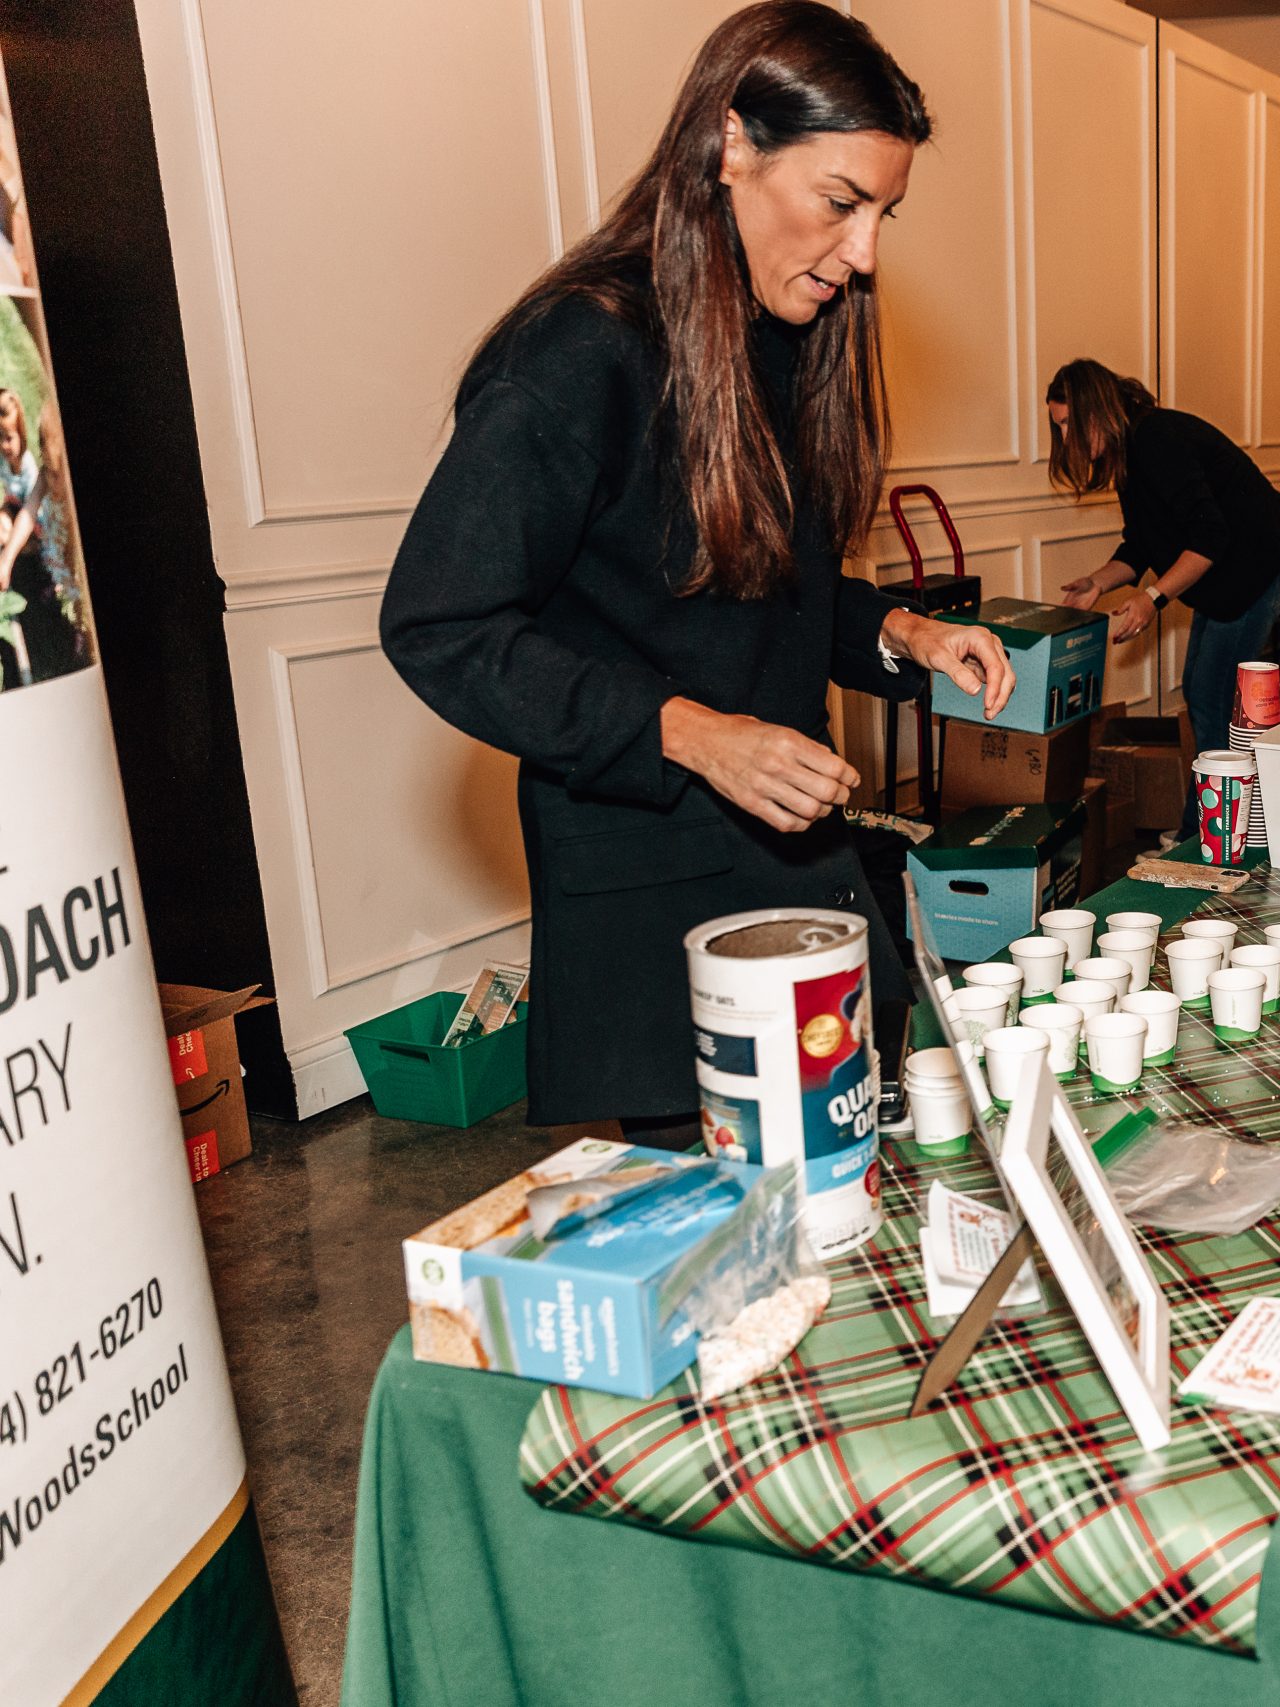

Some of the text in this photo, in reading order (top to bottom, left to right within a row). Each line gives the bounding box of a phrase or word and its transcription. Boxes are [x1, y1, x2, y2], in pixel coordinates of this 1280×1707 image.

[34, 1276, 163, 1417] 821-6270
[535, 1300, 558, 1352] bags
[557, 1279, 584, 1380] sandwich
